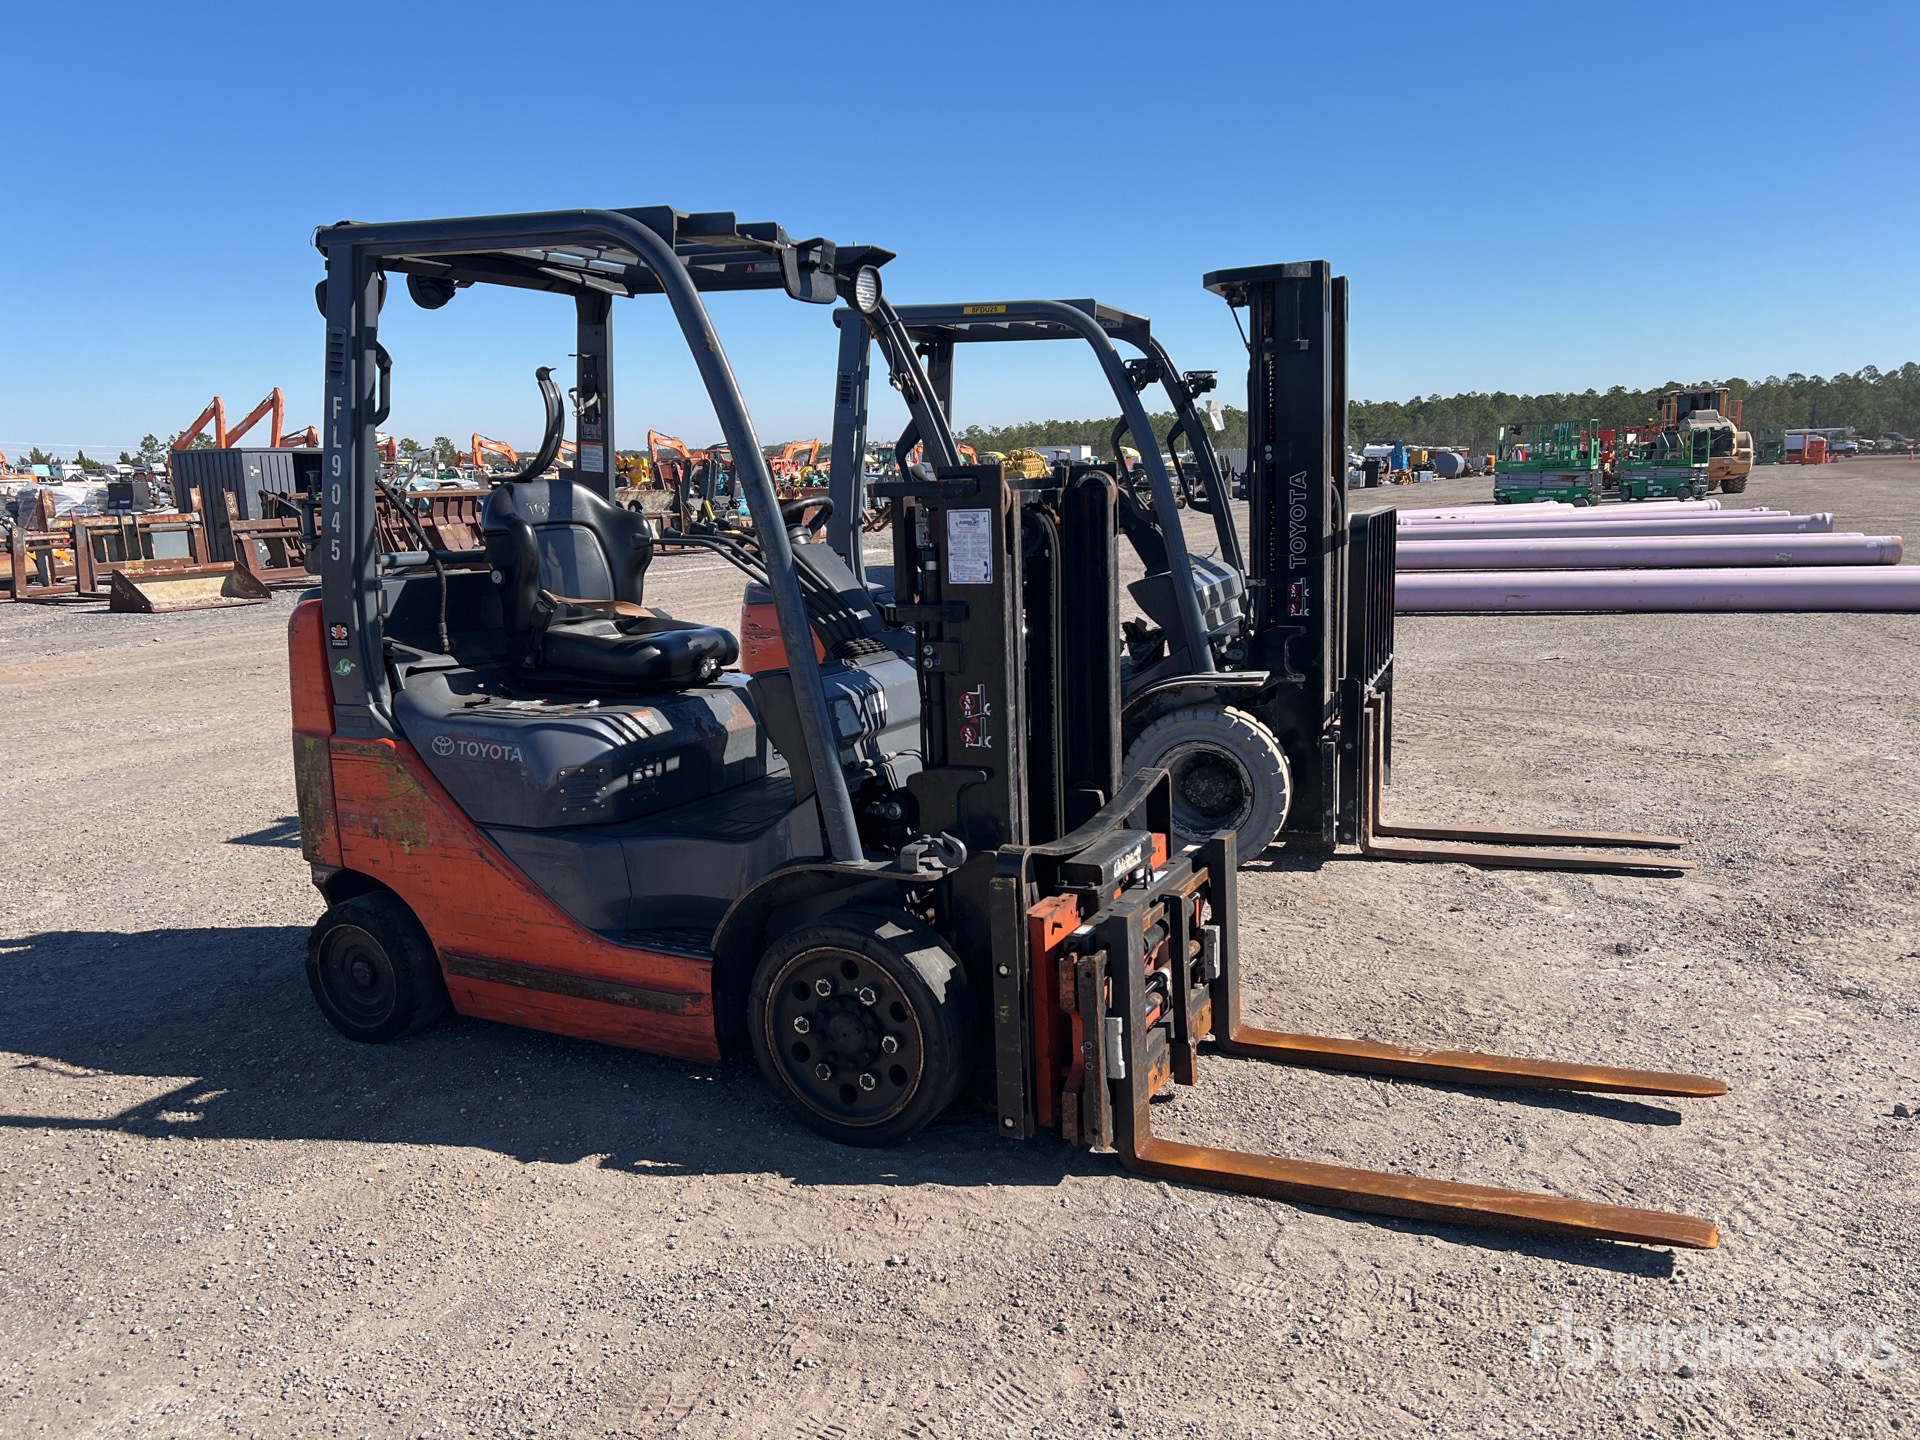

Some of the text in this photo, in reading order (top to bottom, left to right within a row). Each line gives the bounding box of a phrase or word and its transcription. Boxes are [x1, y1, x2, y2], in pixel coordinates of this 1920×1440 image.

[1289, 470, 1307, 570] TOYOTA
[330, 624, 348, 639] SAS
[457, 740, 524, 763] TOYOTA
